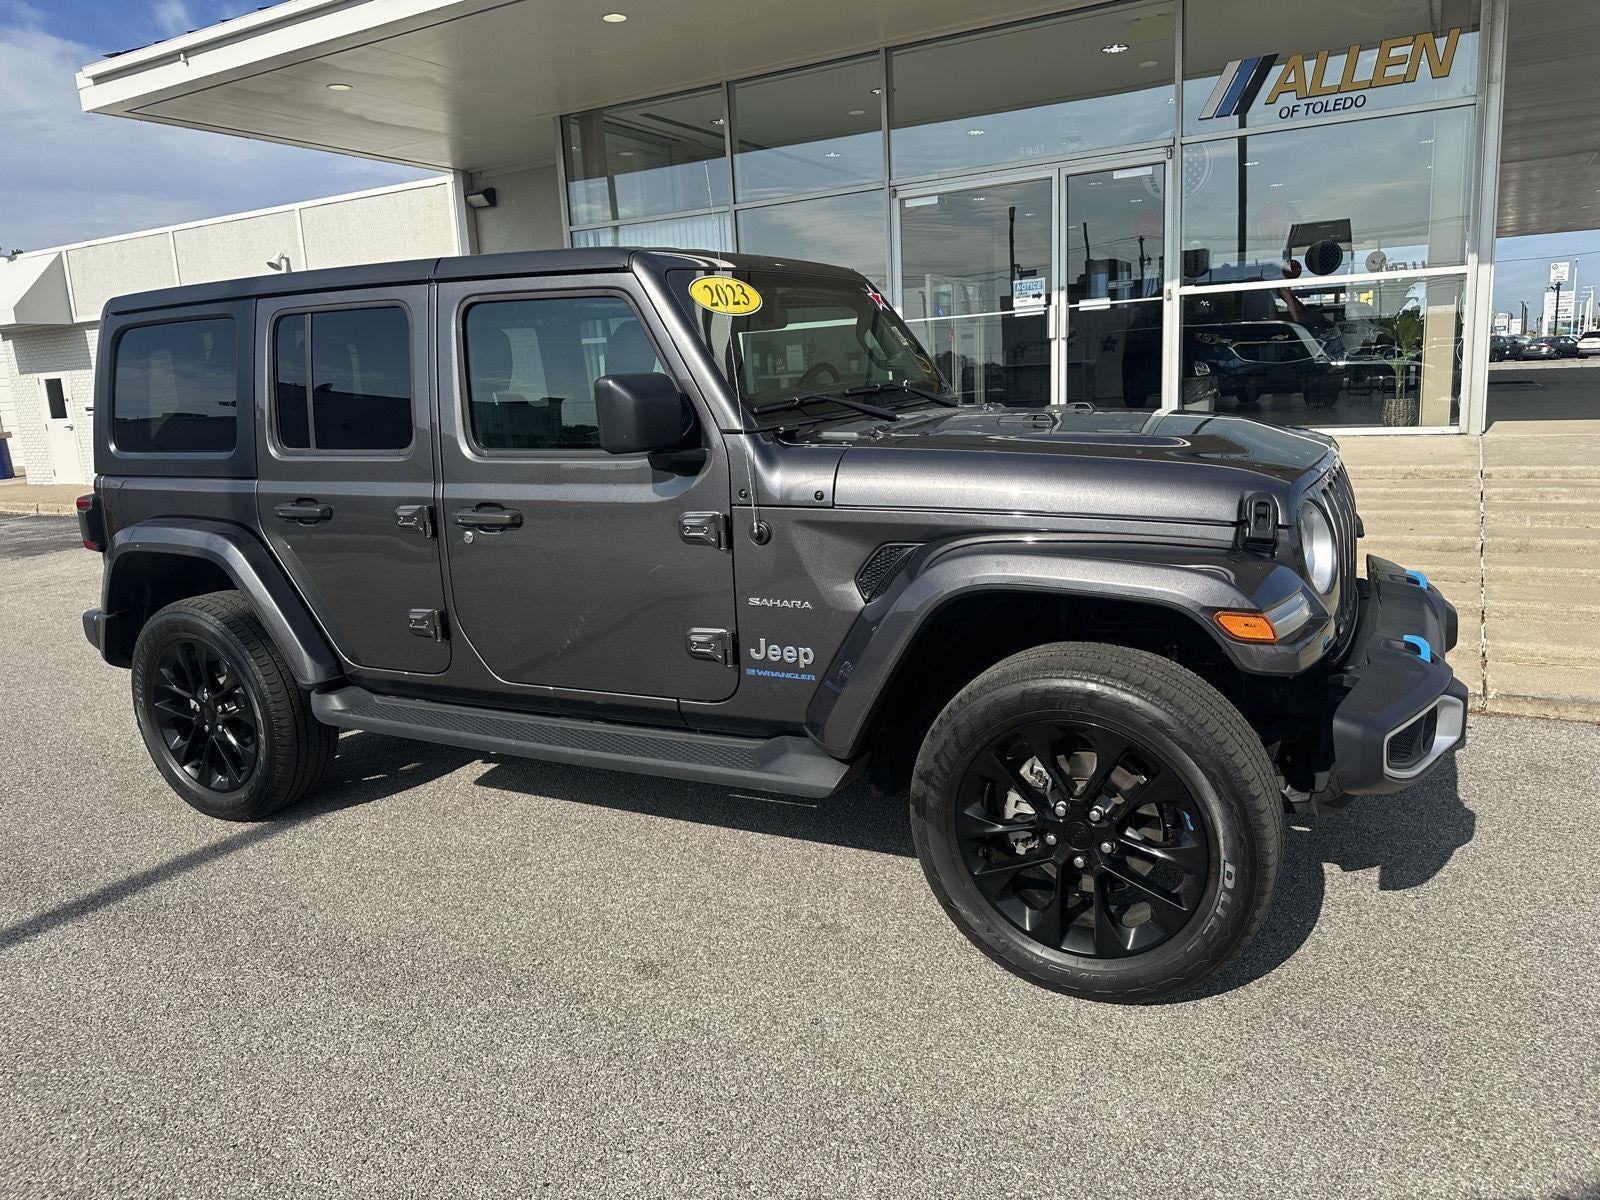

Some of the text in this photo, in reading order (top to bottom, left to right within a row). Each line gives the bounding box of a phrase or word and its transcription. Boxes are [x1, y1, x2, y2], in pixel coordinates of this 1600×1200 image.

[1264, 27, 1461, 105] ALLEN
[1278, 94, 1367, 120] OF TOLEDO
[1018, 144, 1044, 158] 5941
[702, 283, 750, 307] 2023
[1016, 281, 1042, 291] NOTICE
[748, 597, 813, 610] SAHARA
[750, 638, 815, 668] Jeep
[756, 669, 816, 681] WRANGLER
